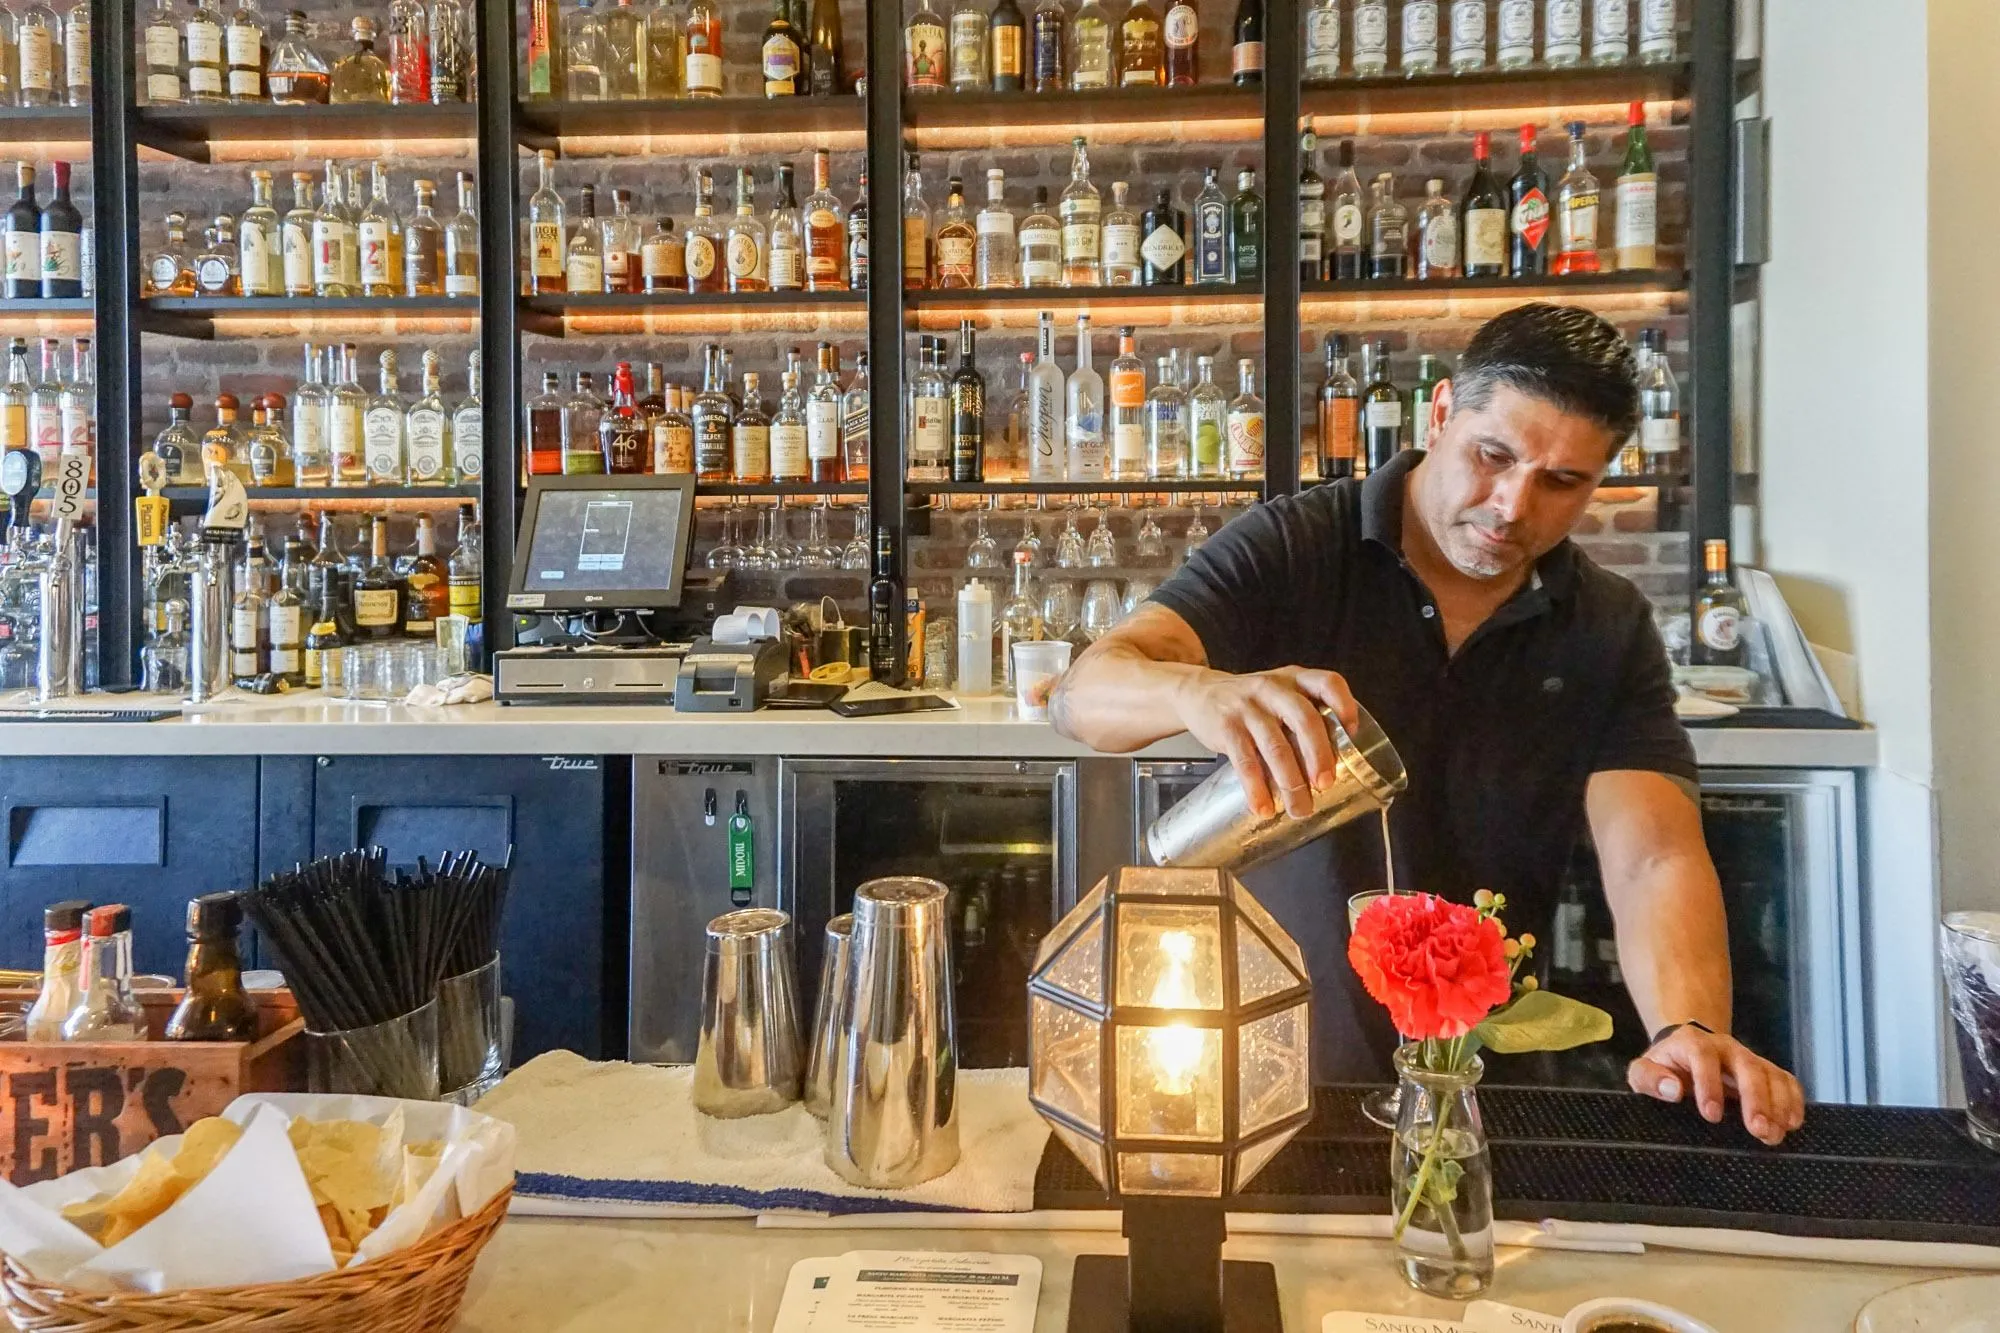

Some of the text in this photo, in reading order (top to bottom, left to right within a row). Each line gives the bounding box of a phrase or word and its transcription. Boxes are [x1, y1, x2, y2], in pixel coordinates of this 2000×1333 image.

[368, 241, 379, 264] 2
[612, 433, 637, 460] 46
[542, 756, 598, 769] true
[735, 842, 746, 877] MIDORI
[1365, 1317, 1427, 1333] SANTO
[1510, 1311, 1562, 1333] SANT
